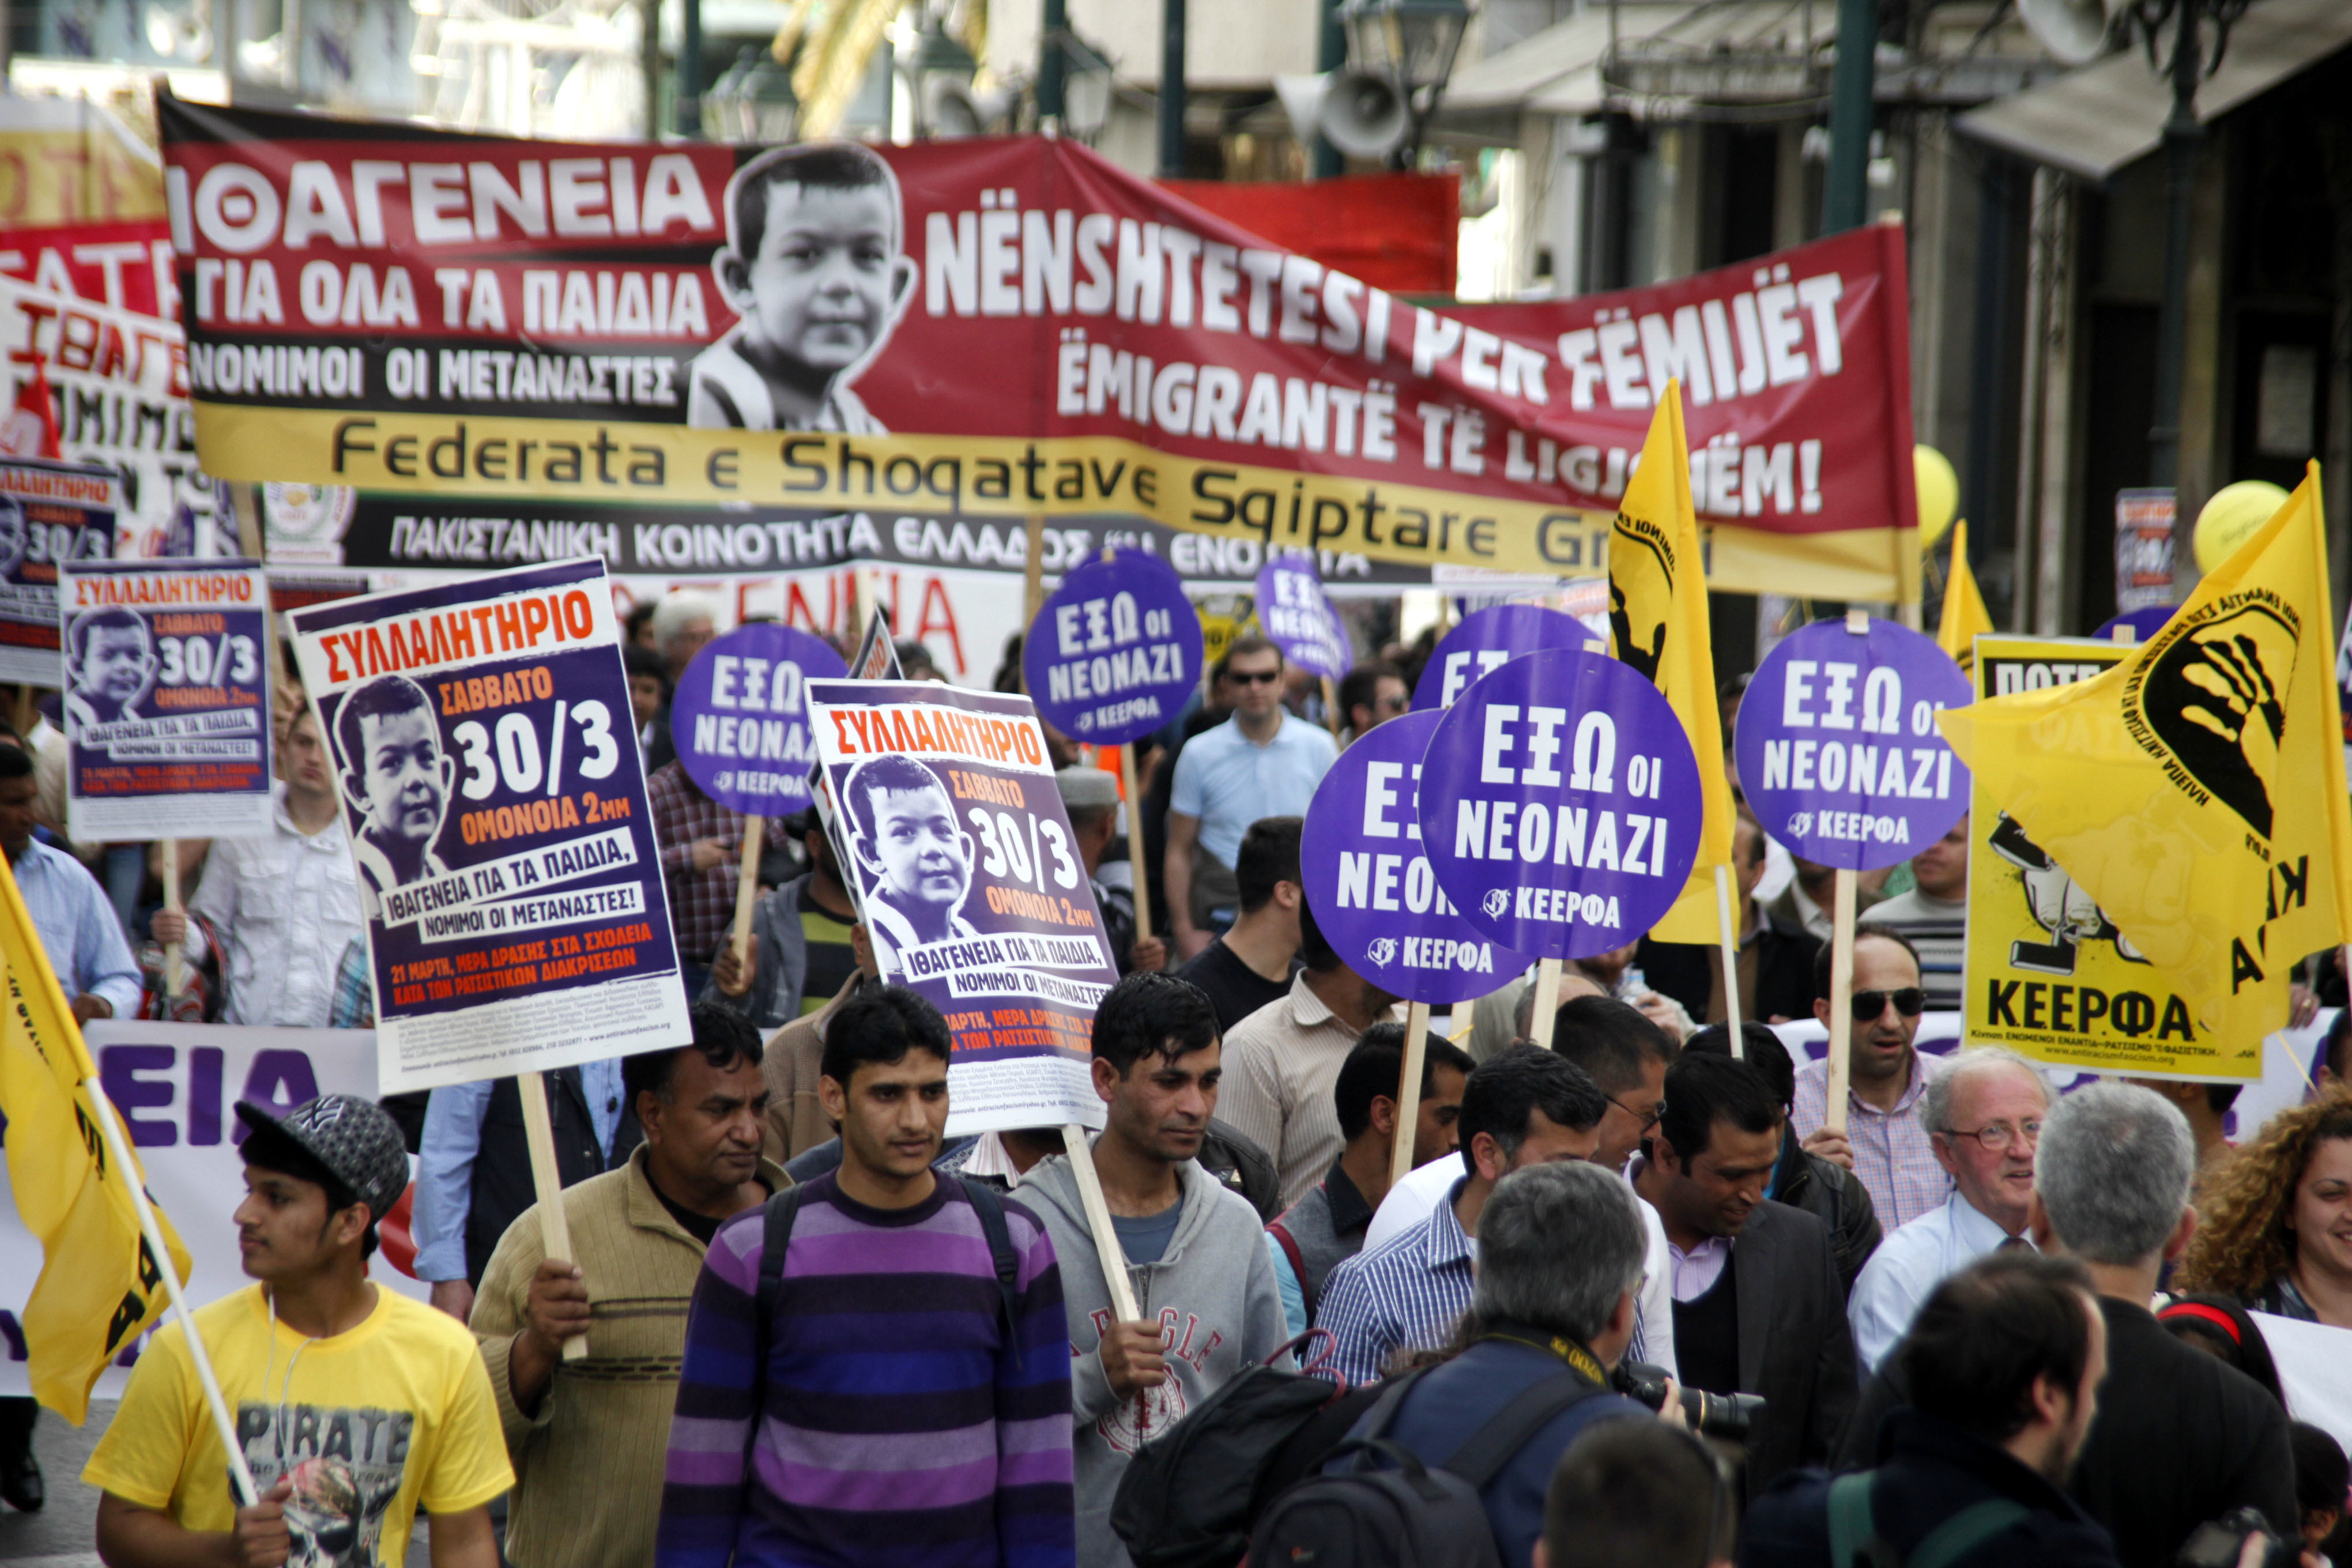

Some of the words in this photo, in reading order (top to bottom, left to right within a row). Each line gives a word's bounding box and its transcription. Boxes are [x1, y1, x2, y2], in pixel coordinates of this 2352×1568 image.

[166, 153, 715, 254] ΙΘΑΓΕΝΕΙΑ
[196, 258, 284, 323] ΓΙΑ
[299, 260, 421, 327] ΟΛΑ
[435, 268, 507, 333] ΤΑ
[523, 270, 710, 336] ΠΑΙΔΙΑ
[926, 189, 1391, 363] NËNSHTETESI
[1558, 263, 1843, 412] FËMIJËT
[190, 342, 365, 397] ΝΟΜΙΜΟΙ
[386, 348, 430, 400] ΟΙ
[438, 350, 678, 405] ΜΕΤΑΝΑΣΤΕΣ
[1057, 327, 1397, 462] ËMIGRANTË
[1417, 401, 1486, 477] TË
[331, 416, 666, 489] Federata
[781, 435, 1156, 514] Shoqatave
[1191, 468, 1498, 556] Sqiptare
[1537, 511, 1714, 578] Gri
[389, 515, 621, 565] ΠΑΚΙΣΤΑΝΙΚΗ
[635, 512, 881, 567] ΚΟΙΝΟΤΗΤΑ
[319, 589, 593, 683] ΣΥΛΛΑΛΗΤΗΡΙΟ
[1056, 590, 1141, 657] ΕΞΩ
[158, 632, 257, 688] 30/3
[711, 654, 803, 715] ΕΞΩ
[1047, 642, 1185, 703] ΝΕΟΝΑΖΙ
[438, 666, 554, 715] ΣΑΒΒΑΤΟ
[1096, 695, 1161, 729] ΚΕΕΡΦΑ
[1782, 659, 1902, 735] ΕΞΩ
[452, 699, 620, 800] 30/3
[829, 709, 1043, 766] ΣΥΛΛΑΛΗΤΗΡΙΟ
[1480, 703, 1616, 794] ΕΞΩ
[736, 770, 808, 798] ΚΕΕΡΦΑ
[948, 770, 1026, 809] ΣΑΒΒΑΤΟ
[1762, 739, 1953, 800] ΝΕΟΝΑΖΙ
[461, 796, 579, 845] ΟΜΟΝΟΙΑ
[968, 807, 1079, 894] 30/3
[1454, 798, 1668, 877] ΝΕΟΝΑΖΙ
[1817, 809, 1910, 845] ΚΕΕΡΦΑ
[386, 876, 471, 921] ΙΘΑΓΕΝΕΙΑ
[473, 866, 506, 898] ΓΙΑ
[508, 858, 539, 887] ΤΑ
[542, 836, 631, 879] ΠΑΙΔΙΑ,
[986, 885, 1063, 930] ΟΜΟΝΟΙΑ
[1514, 886, 1621, 929] ΚΕΕΡΦΑ
[424, 913, 485, 938] ΝΟΜΙΜΟΙ
[489, 909, 507, 929] ΟΙ
[511, 887, 636, 925] ΜΕΤΑΝΑΣΤΕΣ!
[394, 983, 426, 1006] ΚΑΤΑ
[428, 979, 454, 1001] ΤΩΝ
[541, 947, 638, 982] ΔΙΑΚΡΙΣΕΩΝ
[408, 956, 455, 982] ΜΑΡΤΗ,
[457, 950, 489, 972] ΜΕΡΑ
[491, 940, 547, 968] ΔΡΑΣΗΣ
[551, 934, 581, 958] ΣΤΑ
[585, 922, 653, 951] ΣΧΟΛΕΙΑ
[907, 939, 1005, 977] ΙΘΑΓΕΝΕΙΑ
[1004, 938, 1030, 962] ΓΙΑ
[1030, 938, 1049, 963] ΤΑ
[1047, 939, 1103, 967] ΠΑΙΔΙΑ,
[1401, 936, 1494, 974] ΚΕΕΡΦΑ
[953, 972, 1021, 993] ΝΟΜΙΜΟΙ
[1024, 973, 1039, 993] ΟΙ
[960, 1031, 991, 1050] ΤΩΝ
[992, 1009, 1030, 1027] ΜΕΡΑ
[2045, 1047, 2176, 1066] www.antiracismfascism.org
[1089, 1306, 1223, 1373] EGLE
[237, 1401, 414, 1463] PIRATE
